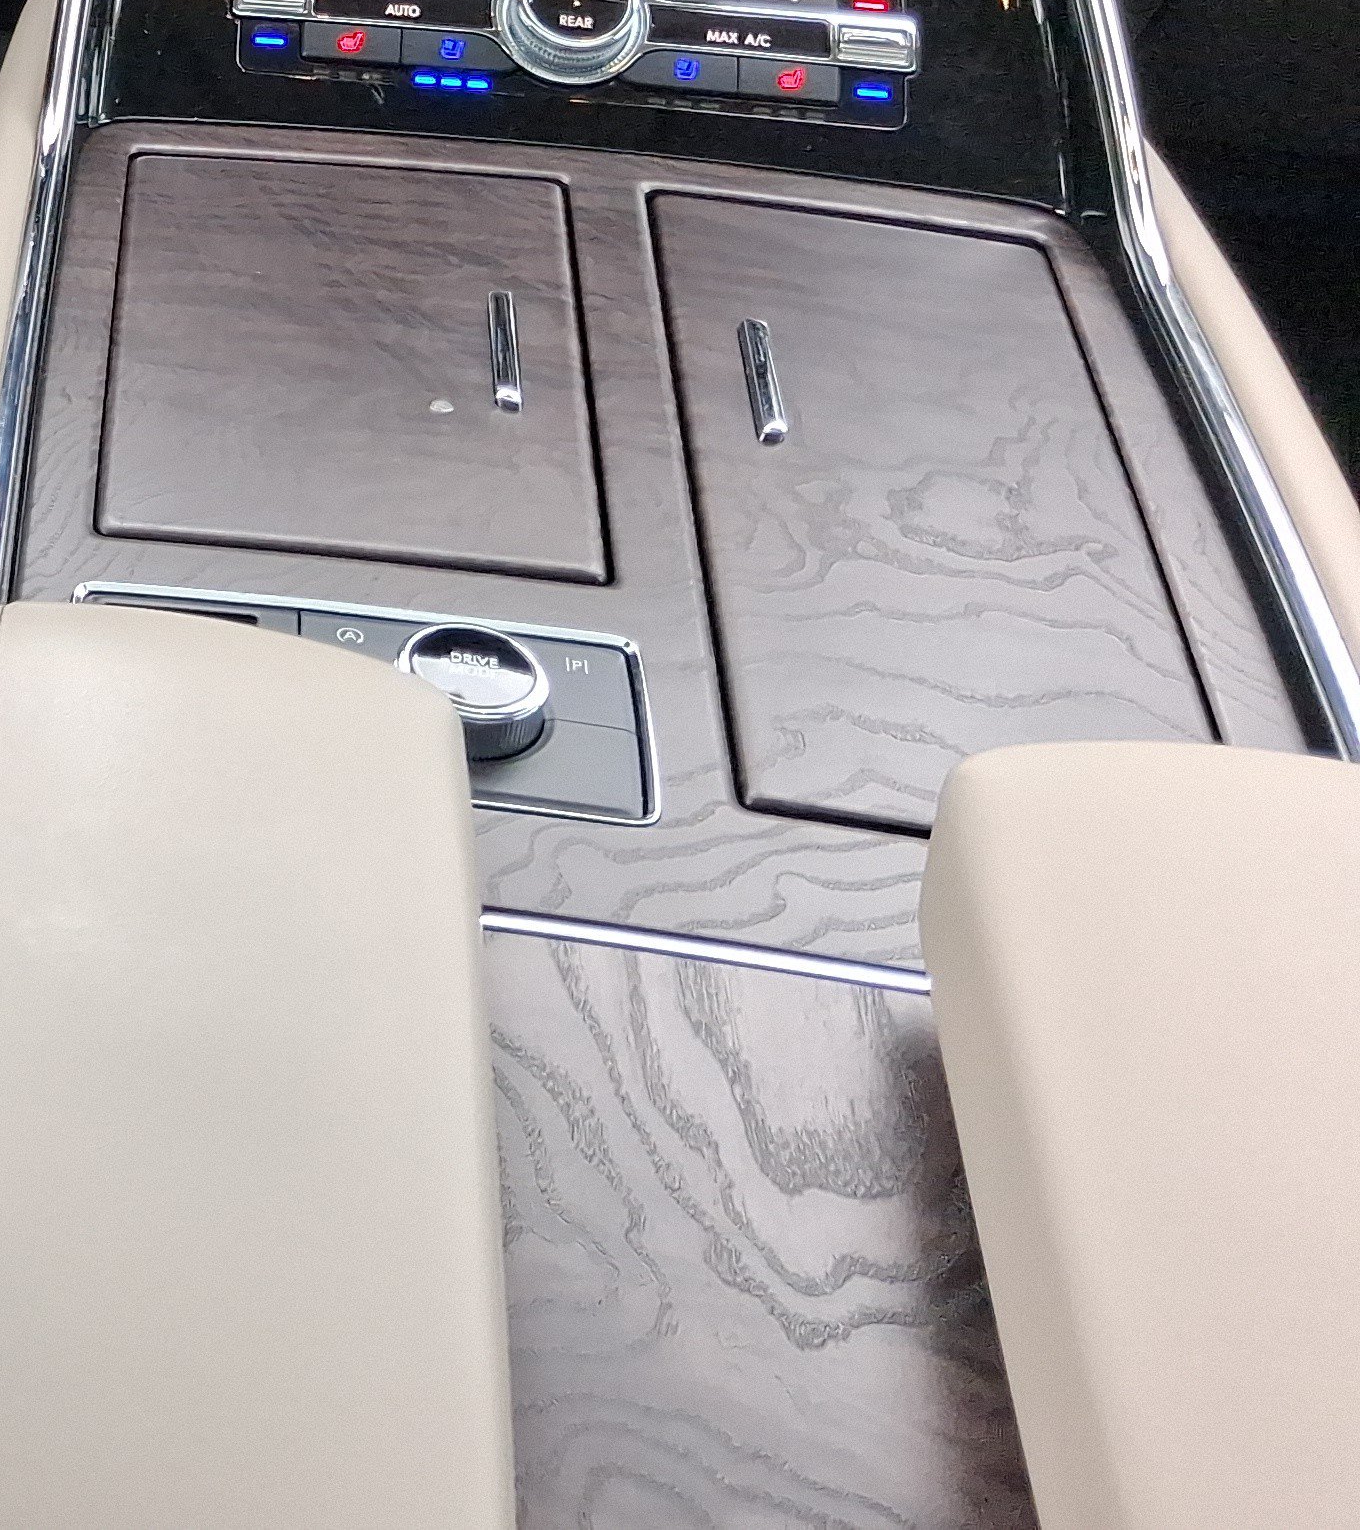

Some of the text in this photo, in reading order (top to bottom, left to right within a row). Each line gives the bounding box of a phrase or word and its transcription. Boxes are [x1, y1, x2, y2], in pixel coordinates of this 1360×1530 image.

[384, 3, 422, 19] AUTO
[559, 14, 594, 30] REAR
[706, 29, 772, 48] MAX A/C
[450, 651, 500, 669] DRIVE
